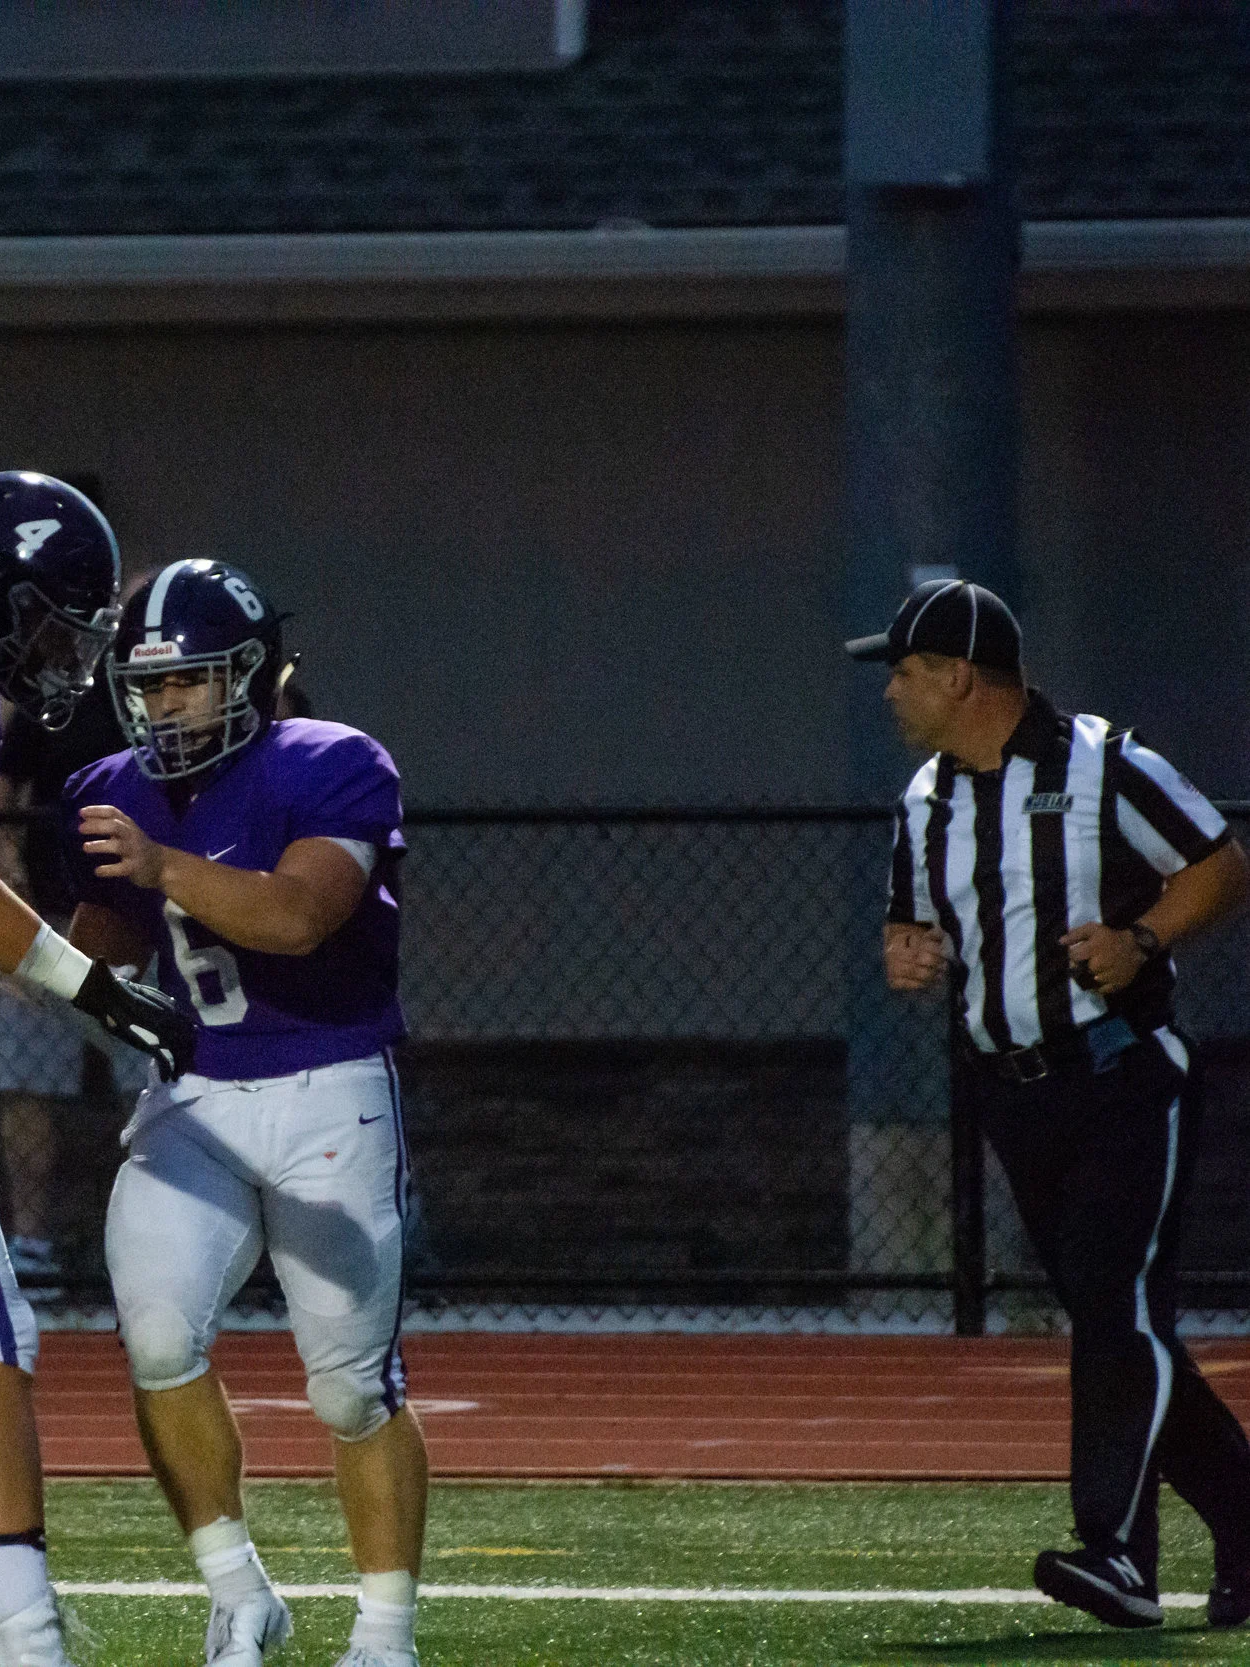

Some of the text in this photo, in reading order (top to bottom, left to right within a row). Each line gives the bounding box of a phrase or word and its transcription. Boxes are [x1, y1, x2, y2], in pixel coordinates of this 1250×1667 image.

[15, 519, 63, 560] 4
[223, 577, 265, 621] 6
[134, 645, 172, 658] Riddell
[163, 899, 249, 1027] 6
